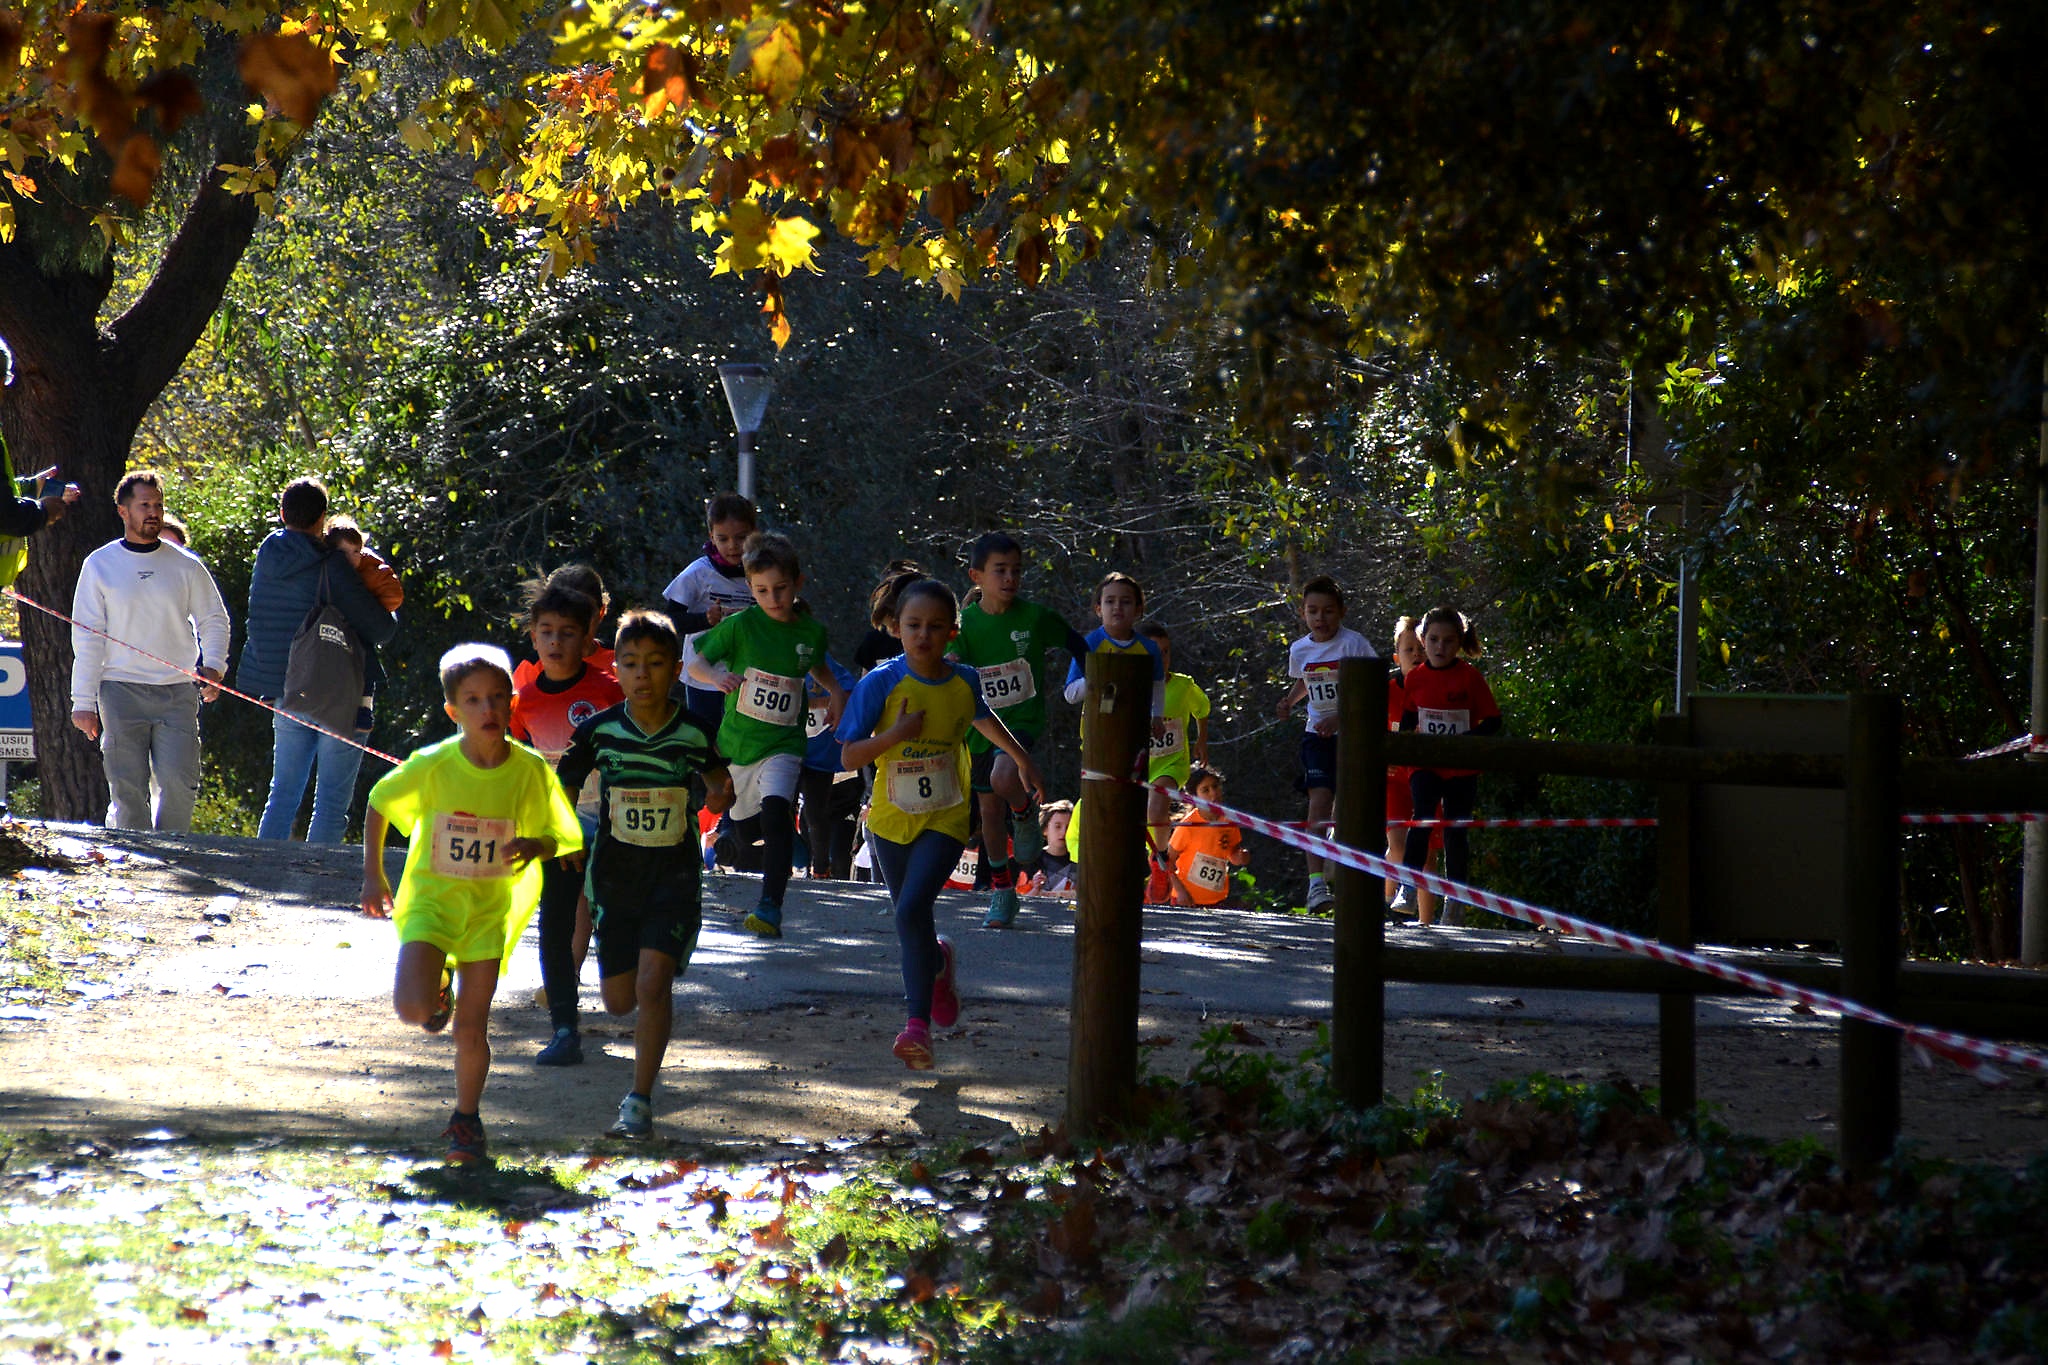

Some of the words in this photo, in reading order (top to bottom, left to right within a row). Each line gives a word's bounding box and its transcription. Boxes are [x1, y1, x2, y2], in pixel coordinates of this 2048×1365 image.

[984, 675, 1021, 699] 594
[1308, 683, 1338, 701] 115
[753, 687, 791, 713] 590
[1428, 722, 1457, 736] 924
[0, 736, 28, 745] USIU
[918, 776, 932, 798] 8
[626, 807, 671, 832] 957
[449, 837, 496, 864] 541
[1199, 866, 1223, 883] 637
